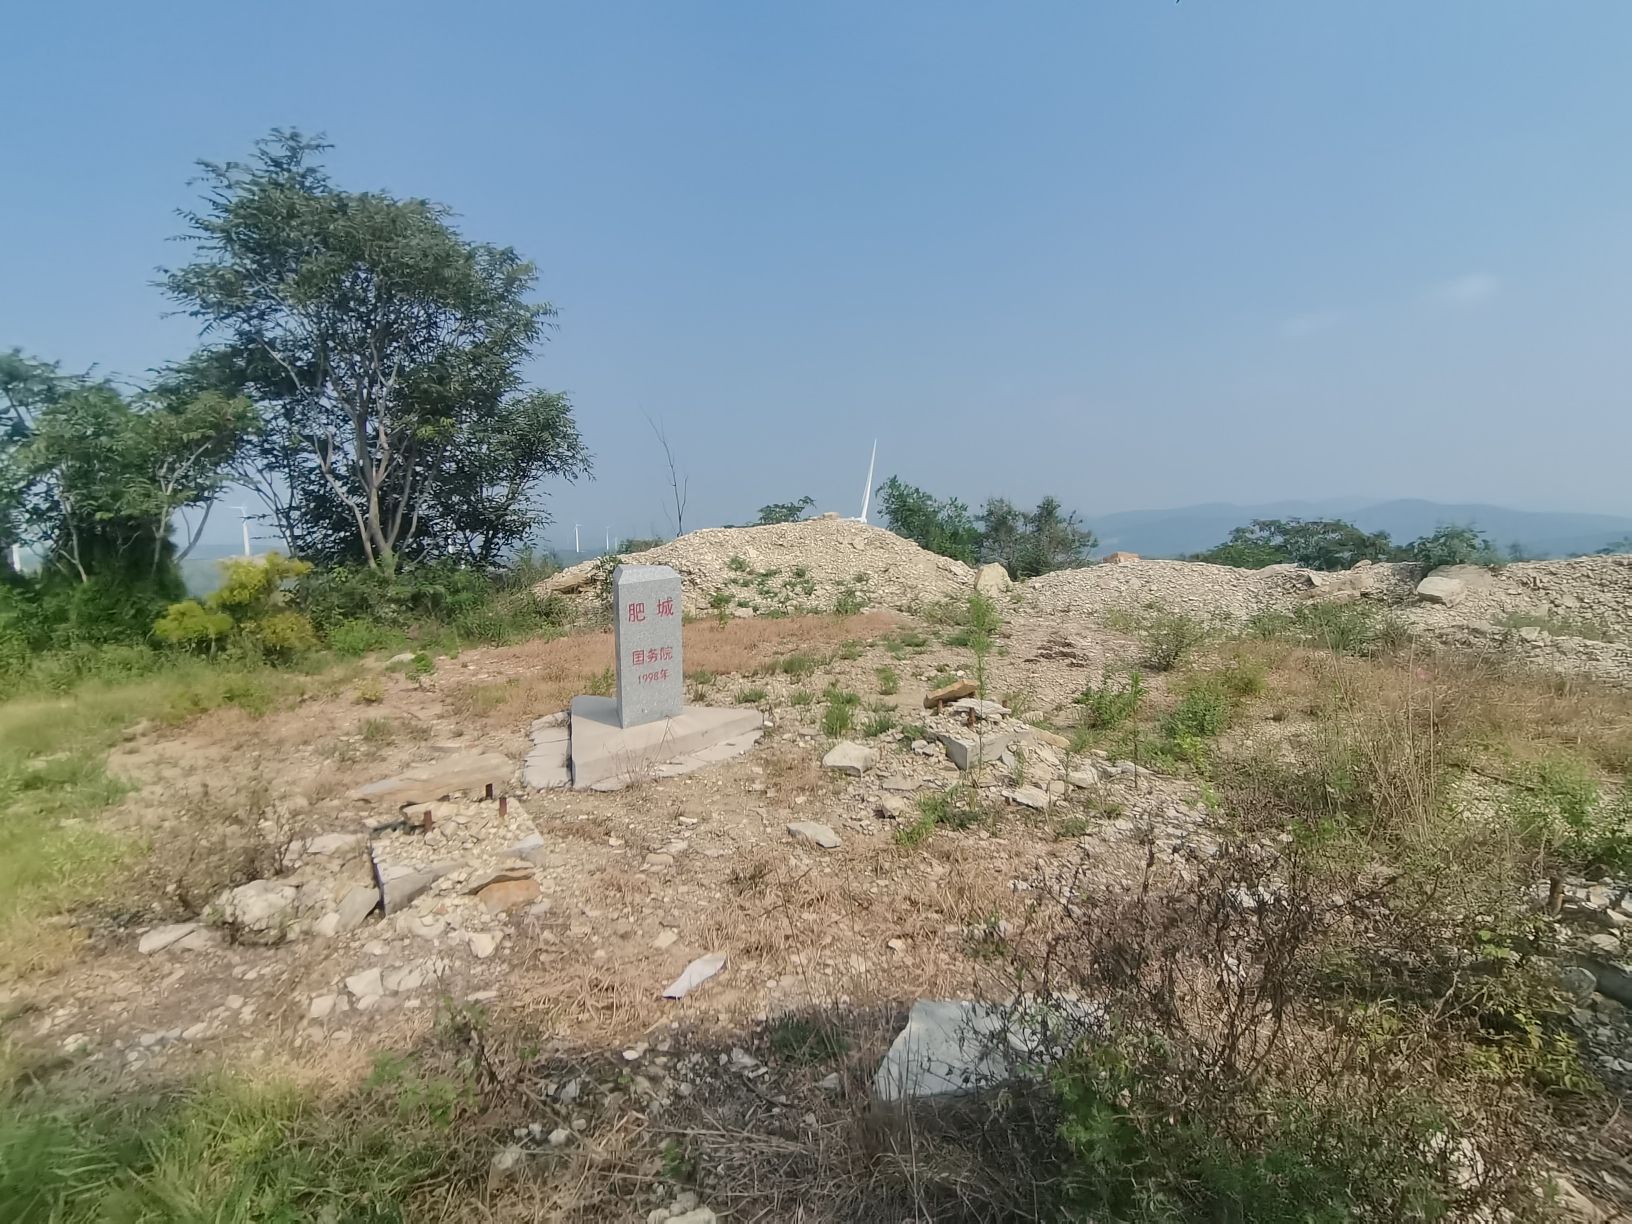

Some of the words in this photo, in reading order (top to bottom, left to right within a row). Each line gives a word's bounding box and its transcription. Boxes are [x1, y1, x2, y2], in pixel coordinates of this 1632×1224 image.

[628, 597, 674, 622] 肥城
[632, 647, 673, 665] 国务院
[638, 668, 669, 684] 1998年
